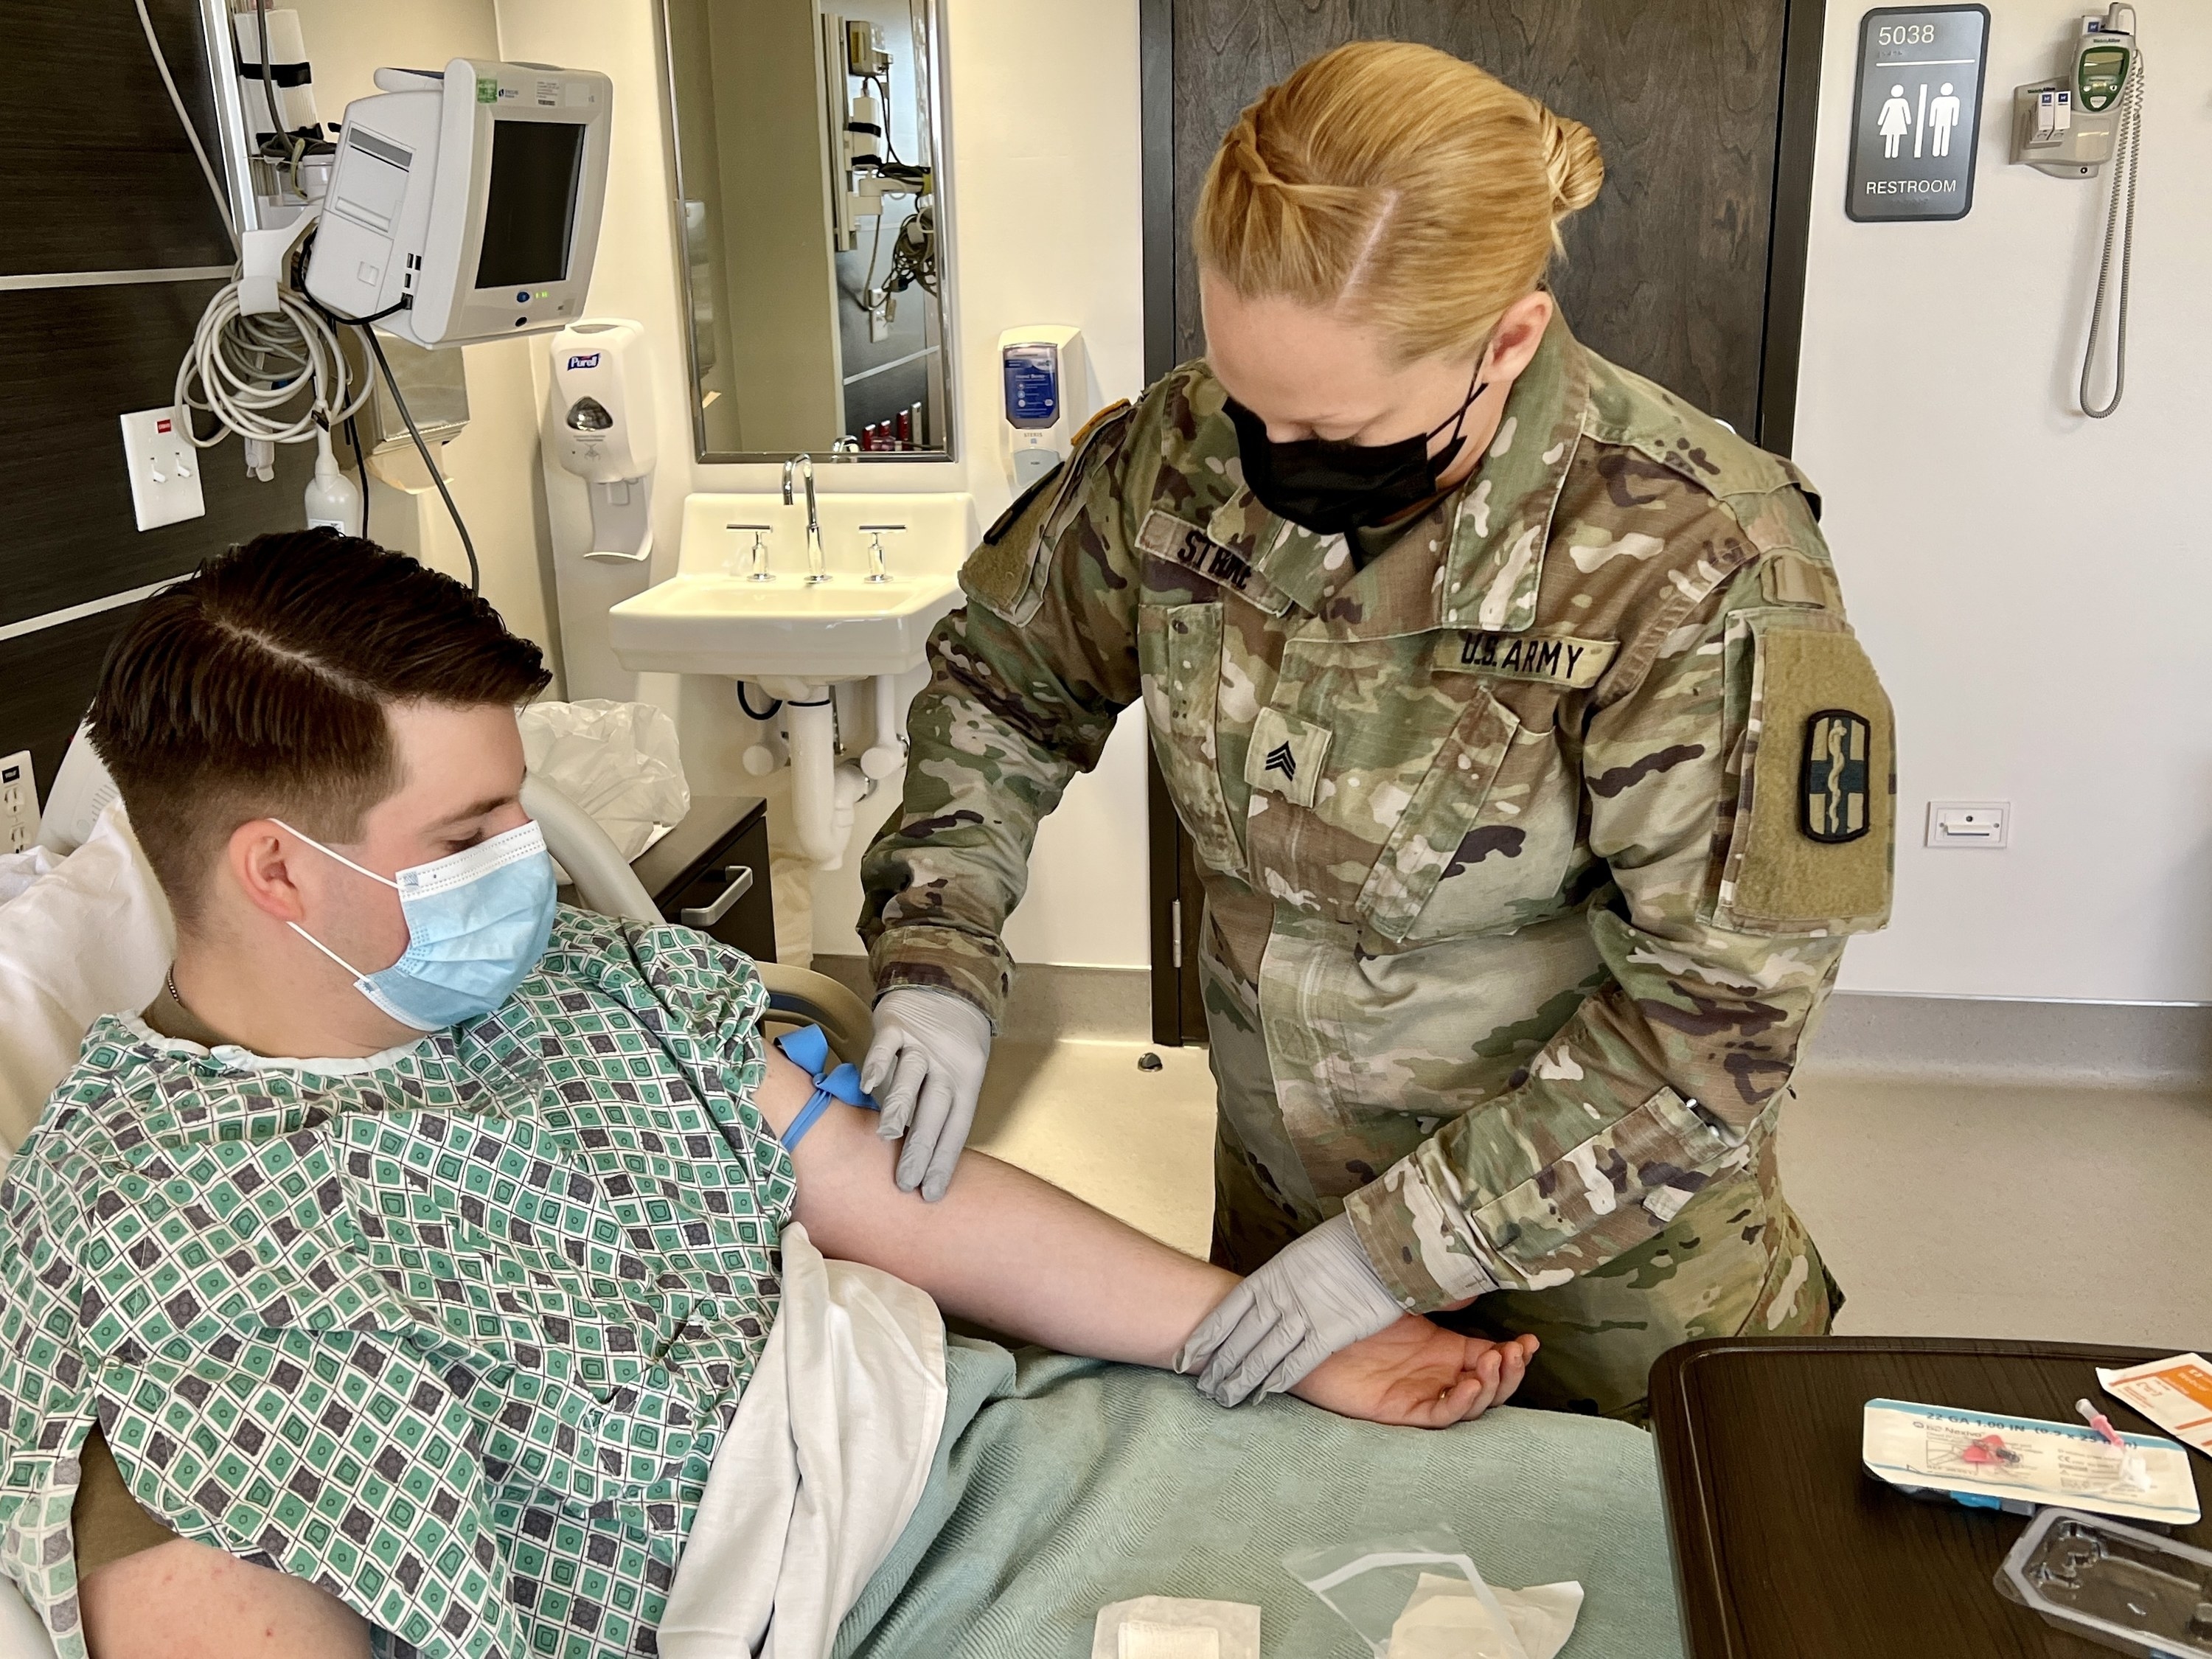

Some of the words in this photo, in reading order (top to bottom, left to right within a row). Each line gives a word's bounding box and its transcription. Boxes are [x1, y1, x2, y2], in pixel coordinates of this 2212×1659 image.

[1878, 24, 1935, 45] 5038
[1866, 180, 1956, 194] RESTROOM
[1461, 632, 1498, 667] U.S.
[1501, 639, 1584, 678] ARMY
[1927, 1412, 1943, 1421] 22
[1948, 1416, 1969, 1425] GA
[1976, 1419, 2004, 1429] 1.00
